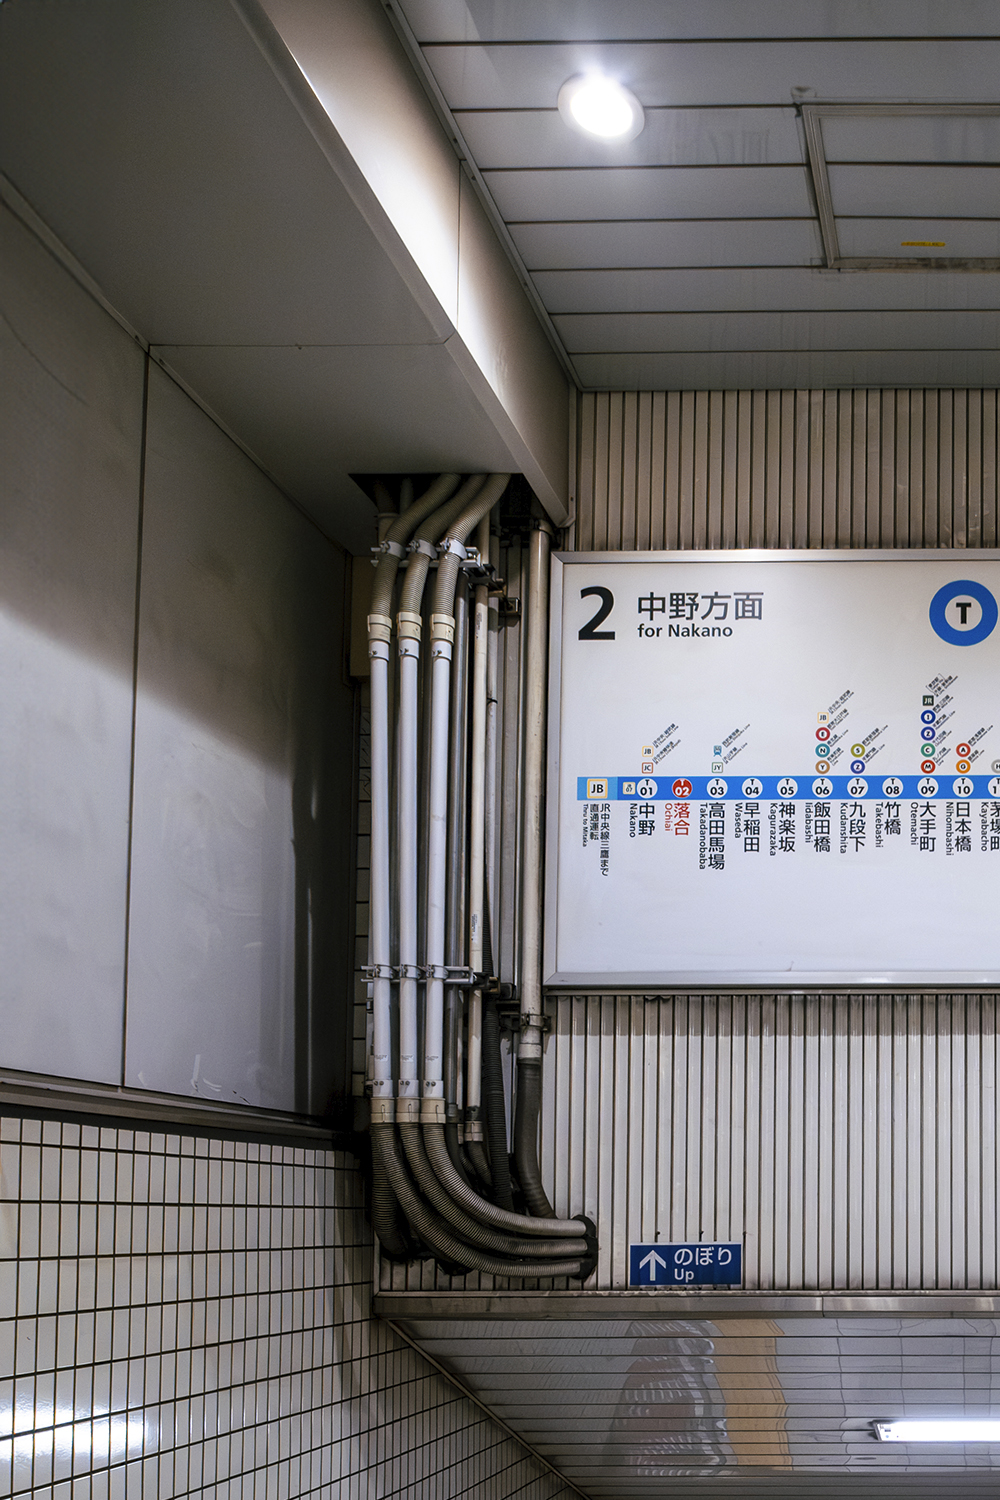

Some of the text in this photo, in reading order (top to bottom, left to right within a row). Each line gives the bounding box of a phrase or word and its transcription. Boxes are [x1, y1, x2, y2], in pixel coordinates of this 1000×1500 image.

[578, 585, 616, 641] 2
[637, 591, 764, 621] 中野方面
[956, 602, 972, 625] T
[637, 623, 733, 638] for Nakano
[591, 784, 604, 794] JB
[640, 787, 653, 796] 01
[676, 787, 690, 796] 02
[711, 787, 725, 795] 03
[746, 786, 760, 795] 04
[781, 786, 795, 795] 05
[816, 786, 830, 795] 06
[851, 786, 865, 795] 07
[887, 786, 901, 795] 08
[922, 786, 936, 794] 09
[957, 785, 970, 794] 10
[629, 803, 638, 838] Nakano
[638, 802, 655, 836] 中野
[664, 803, 673, 832] Ochiai
[673, 802, 690, 836] 落合
[734, 803, 743, 839] Waseda
[743, 802, 760, 853] 早稲田
[768, 803, 778, 856] Kagurazaka
[778, 802, 796, 853] 神楽坂
[805, 802, 814, 843] Iidabashi
[813, 802, 831, 853] 飯田橋
[840, 802, 848, 854] Kudanshita
[849, 801, 866, 853] 九段下
[875, 802, 884, 848] Takebashi
[884, 801, 901, 835] 竹橋
[910, 802, 919, 846] Otemachi
[919, 801, 937, 853] 大手町
[945, 802, 954, 856] Nihombashi
[954, 801, 972, 852] 日本橋
[979, 802, 989, 852] Kayabacho
[708, 802, 726, 870] 高田馬場
[674, 1247, 732, 1266] のぼり
[674, 1268, 695, 1283] Up
